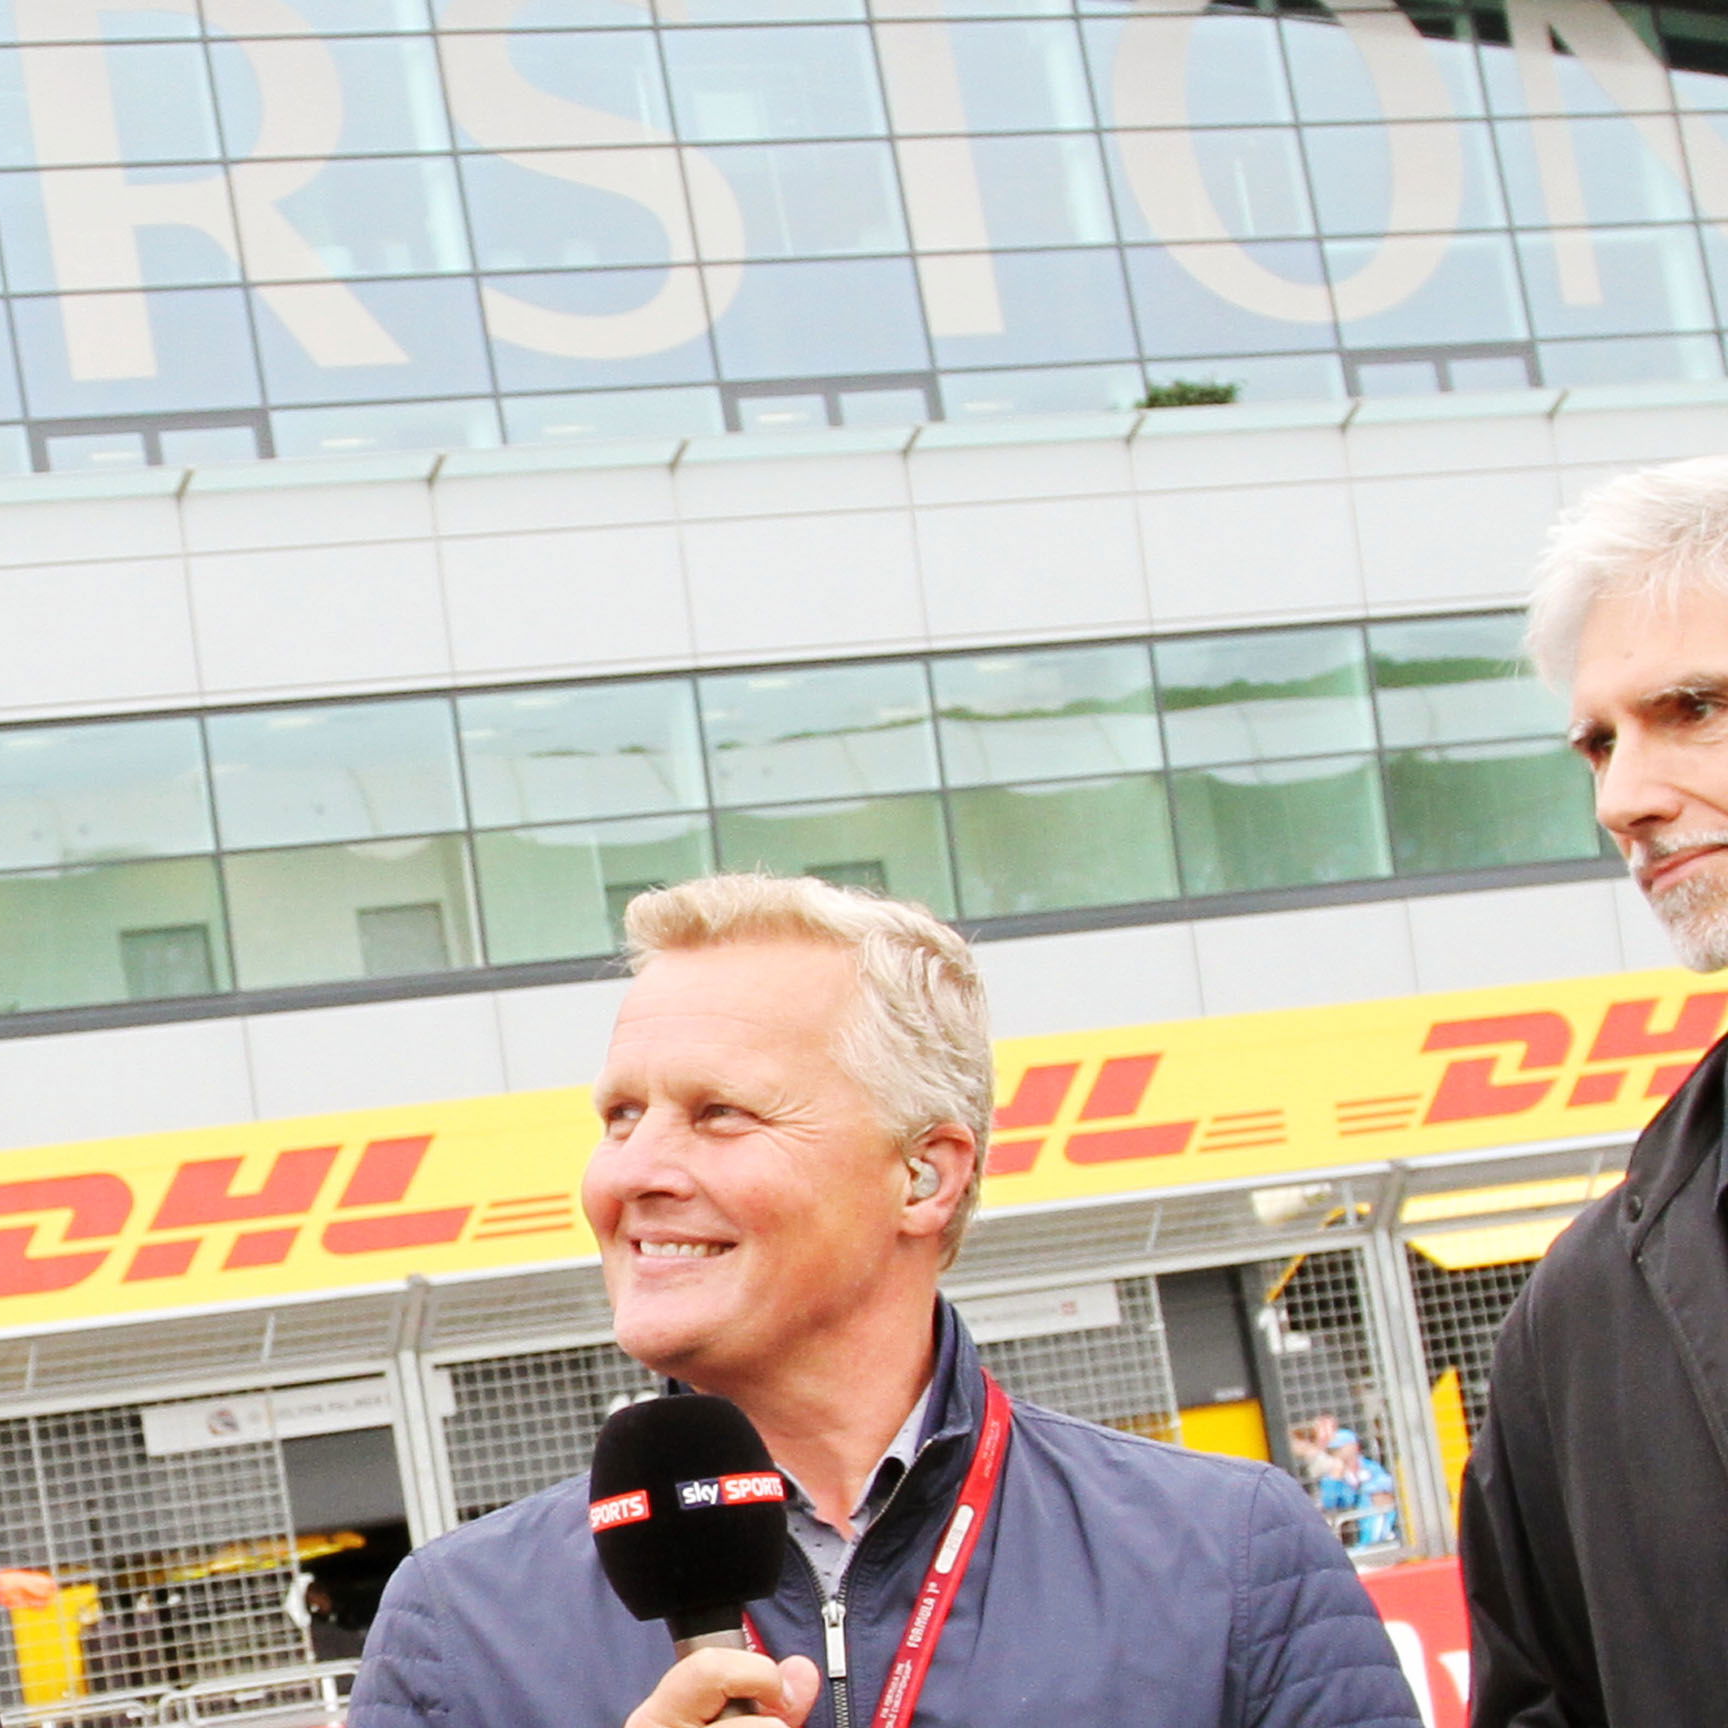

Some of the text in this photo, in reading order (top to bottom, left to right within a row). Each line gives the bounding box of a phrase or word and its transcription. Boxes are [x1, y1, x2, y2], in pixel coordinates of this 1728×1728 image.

[981, 1052, 1200, 1178] HL
[1421, 990, 1728, 1126] DH
[682, 1476, 784, 1505] sky SPORTS
